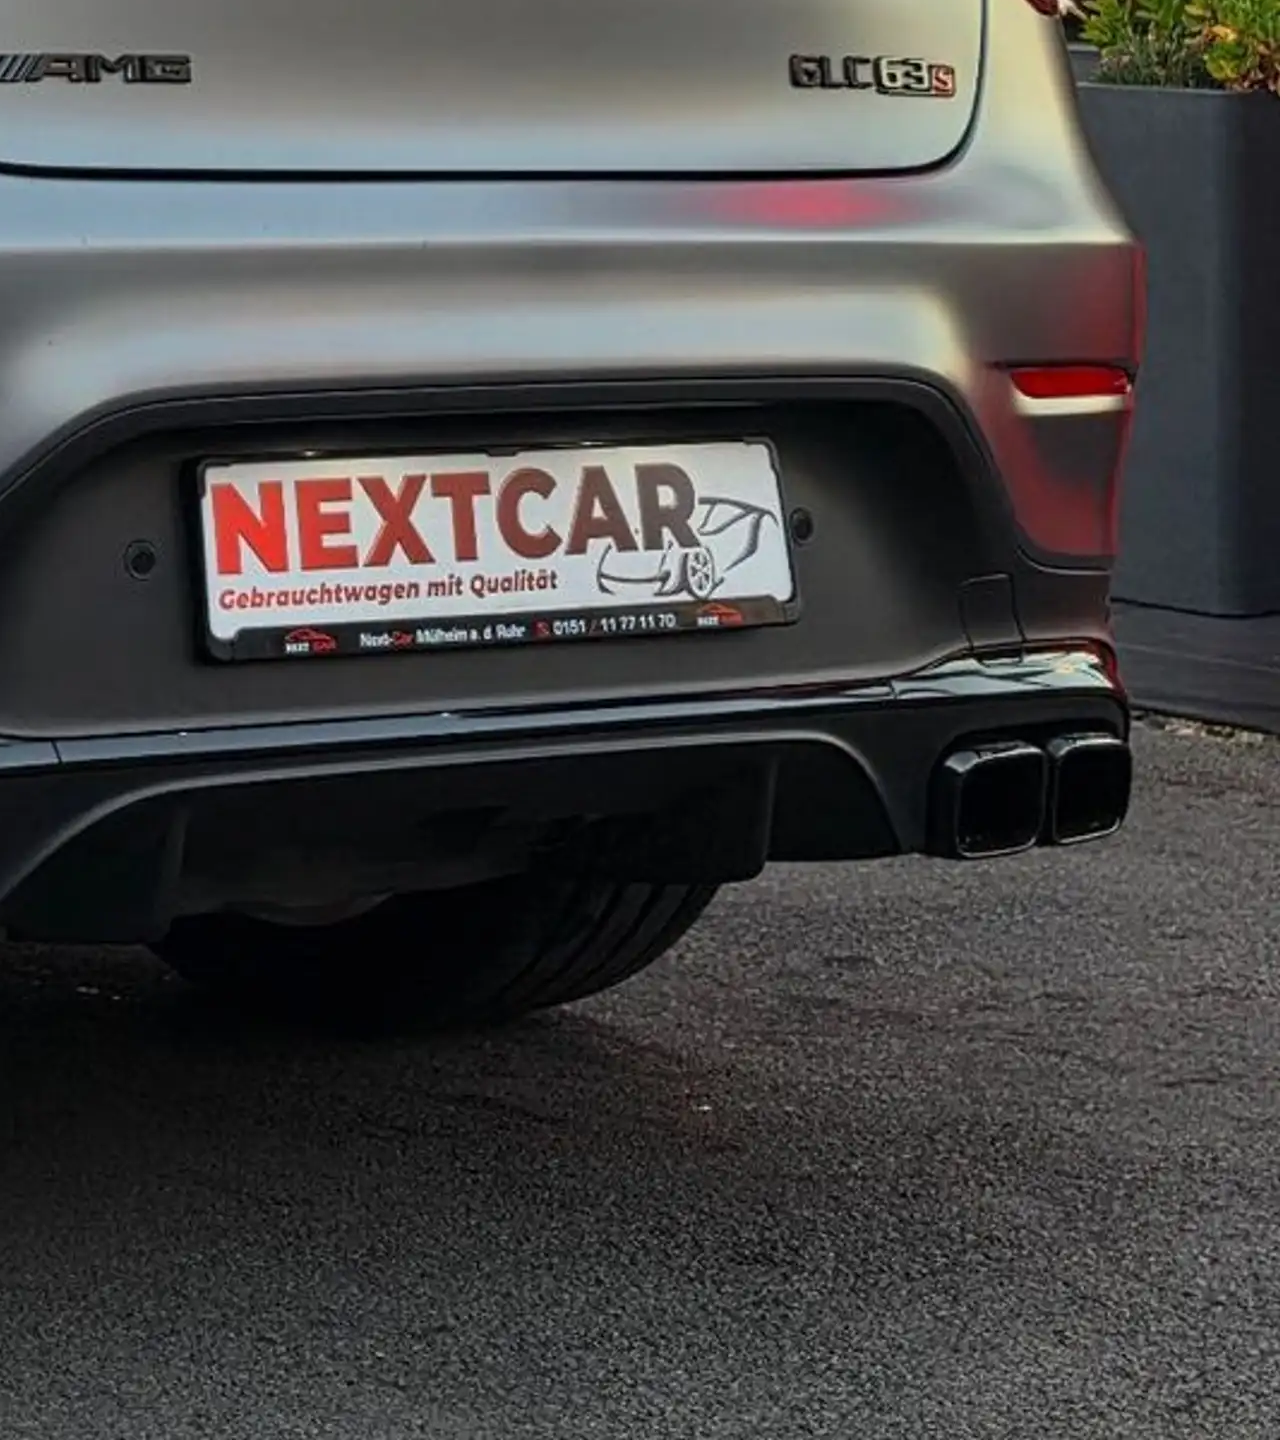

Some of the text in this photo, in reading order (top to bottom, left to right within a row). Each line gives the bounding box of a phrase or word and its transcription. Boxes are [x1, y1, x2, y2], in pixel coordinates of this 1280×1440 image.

[26, 53, 193, 84] AMG
[209, 462, 702, 577] NEXTCAR
[218, 568, 559, 610] Gebrauchtwagen mit Qualität
[552, 619, 586, 636] 0151
